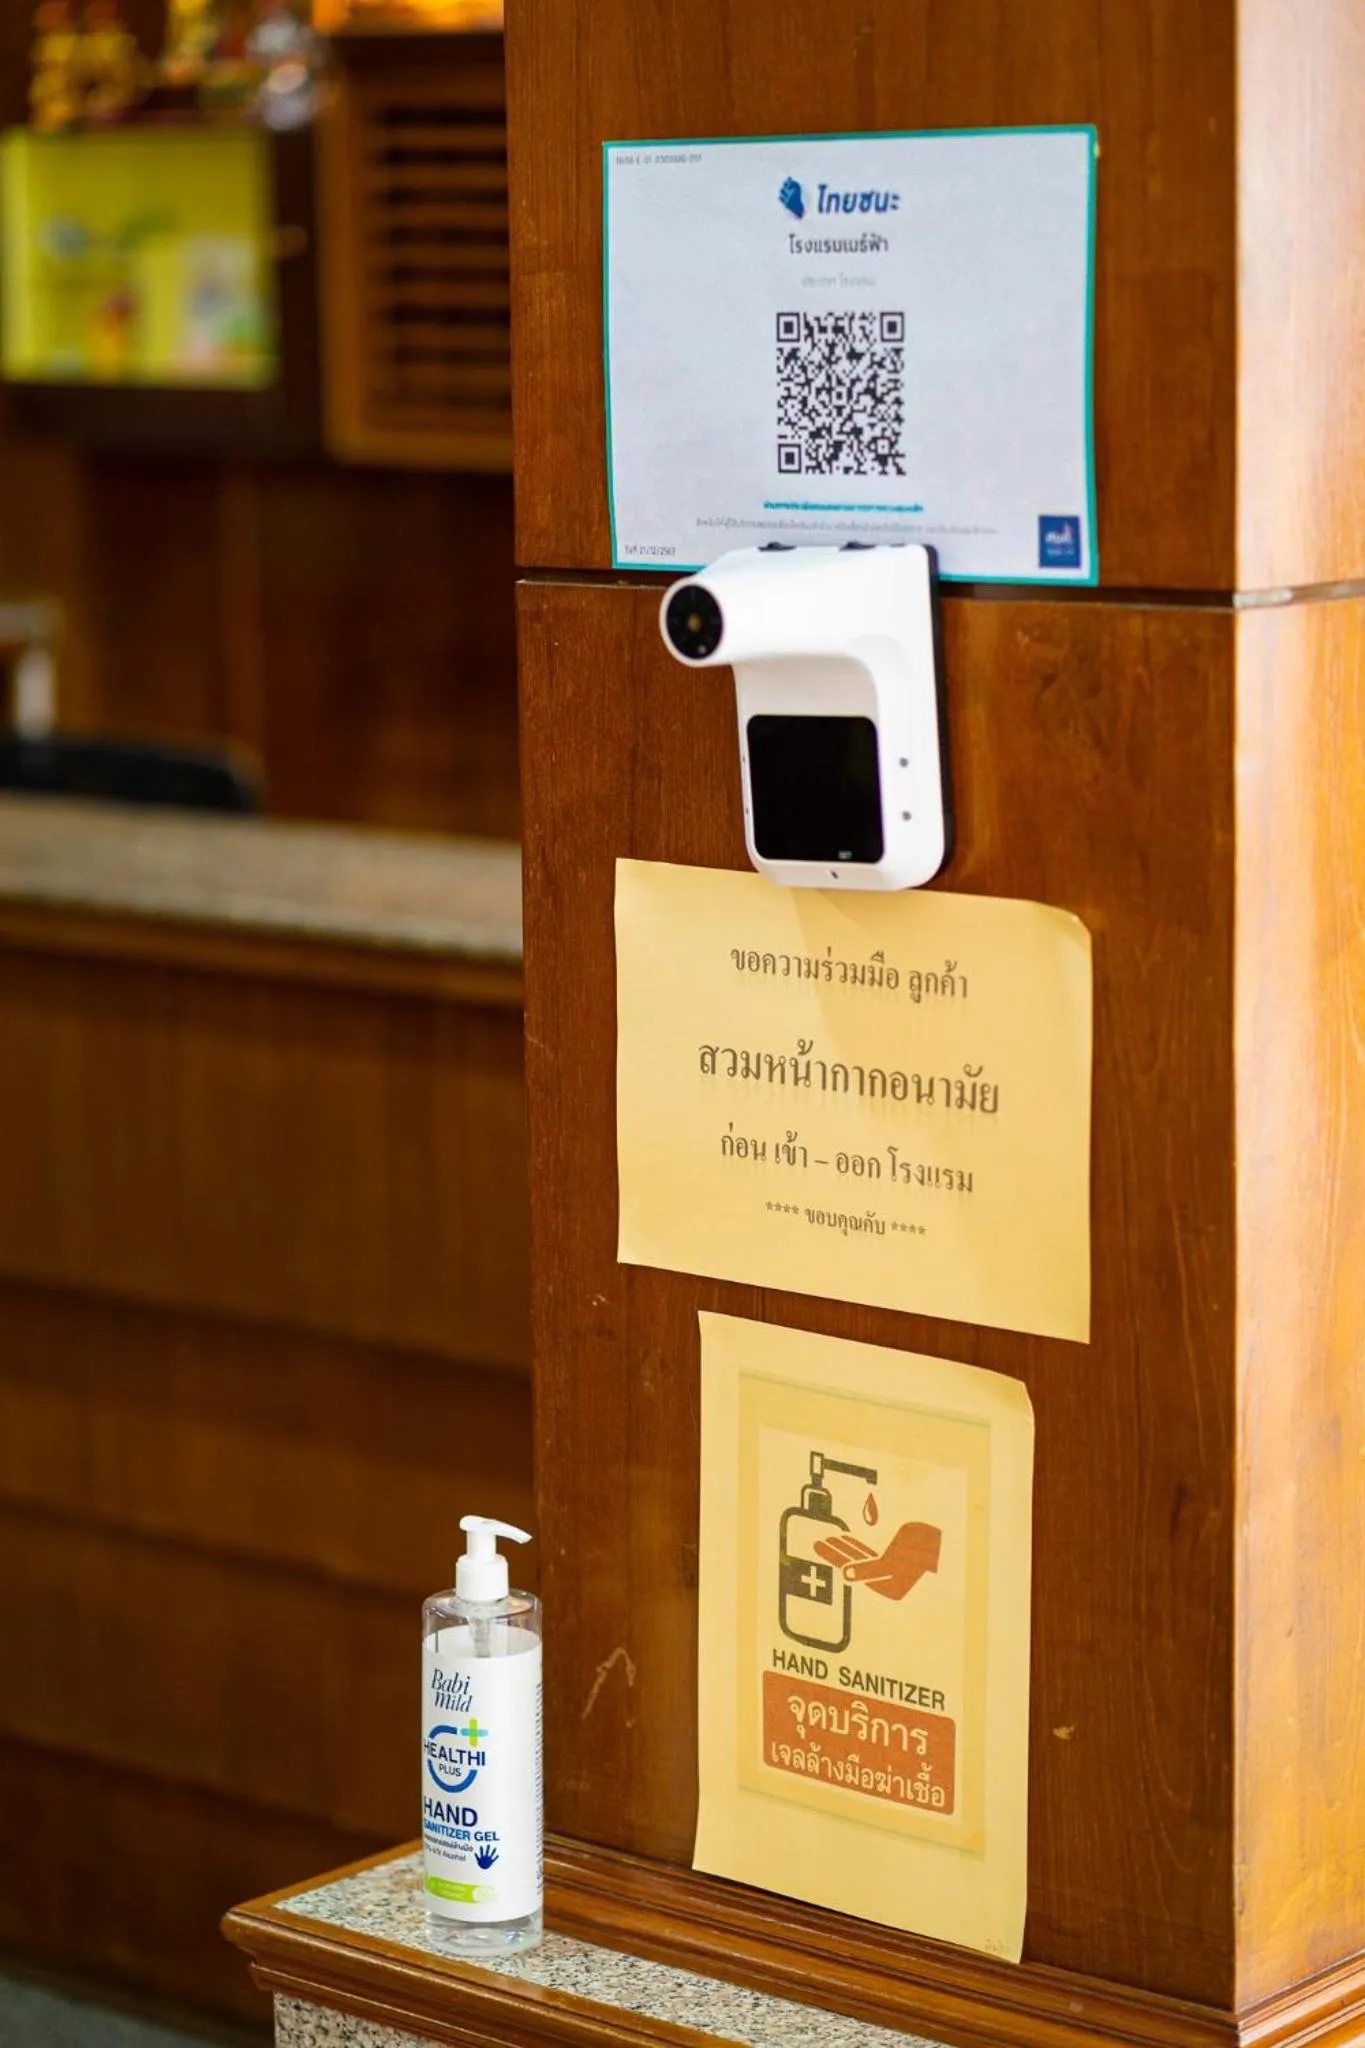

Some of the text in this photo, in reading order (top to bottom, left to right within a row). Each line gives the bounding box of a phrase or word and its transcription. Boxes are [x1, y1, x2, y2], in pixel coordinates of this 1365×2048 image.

[817, 184, 900, 214] ไทยชนะ
[731, 947, 968, 1003] ขอความร่วมมือ ลูกค้า
[698, 1038, 999, 1114] สวมหน้ากากอนามัย
[721, 1122, 767, 1161] ก่อน
[775, 1130, 808, 1168] เข้า
[836, 1152, 881, 1179] ออก
[887, 1146, 973, 1192] โรงแรม
[431, 1668, 471, 1695] Babi
[773, 1649, 945, 1711] HAND SANITIZER
[788, 1696, 928, 1755] จุดบริการ
[438, 1763, 462, 1777] PLUS
[771, 1741, 945, 1807] เจลล้างมือฆ่าเชื้อ
[424, 1796, 478, 1827] HAND
[424, 1819, 500, 1841] SANITIZER GEL
